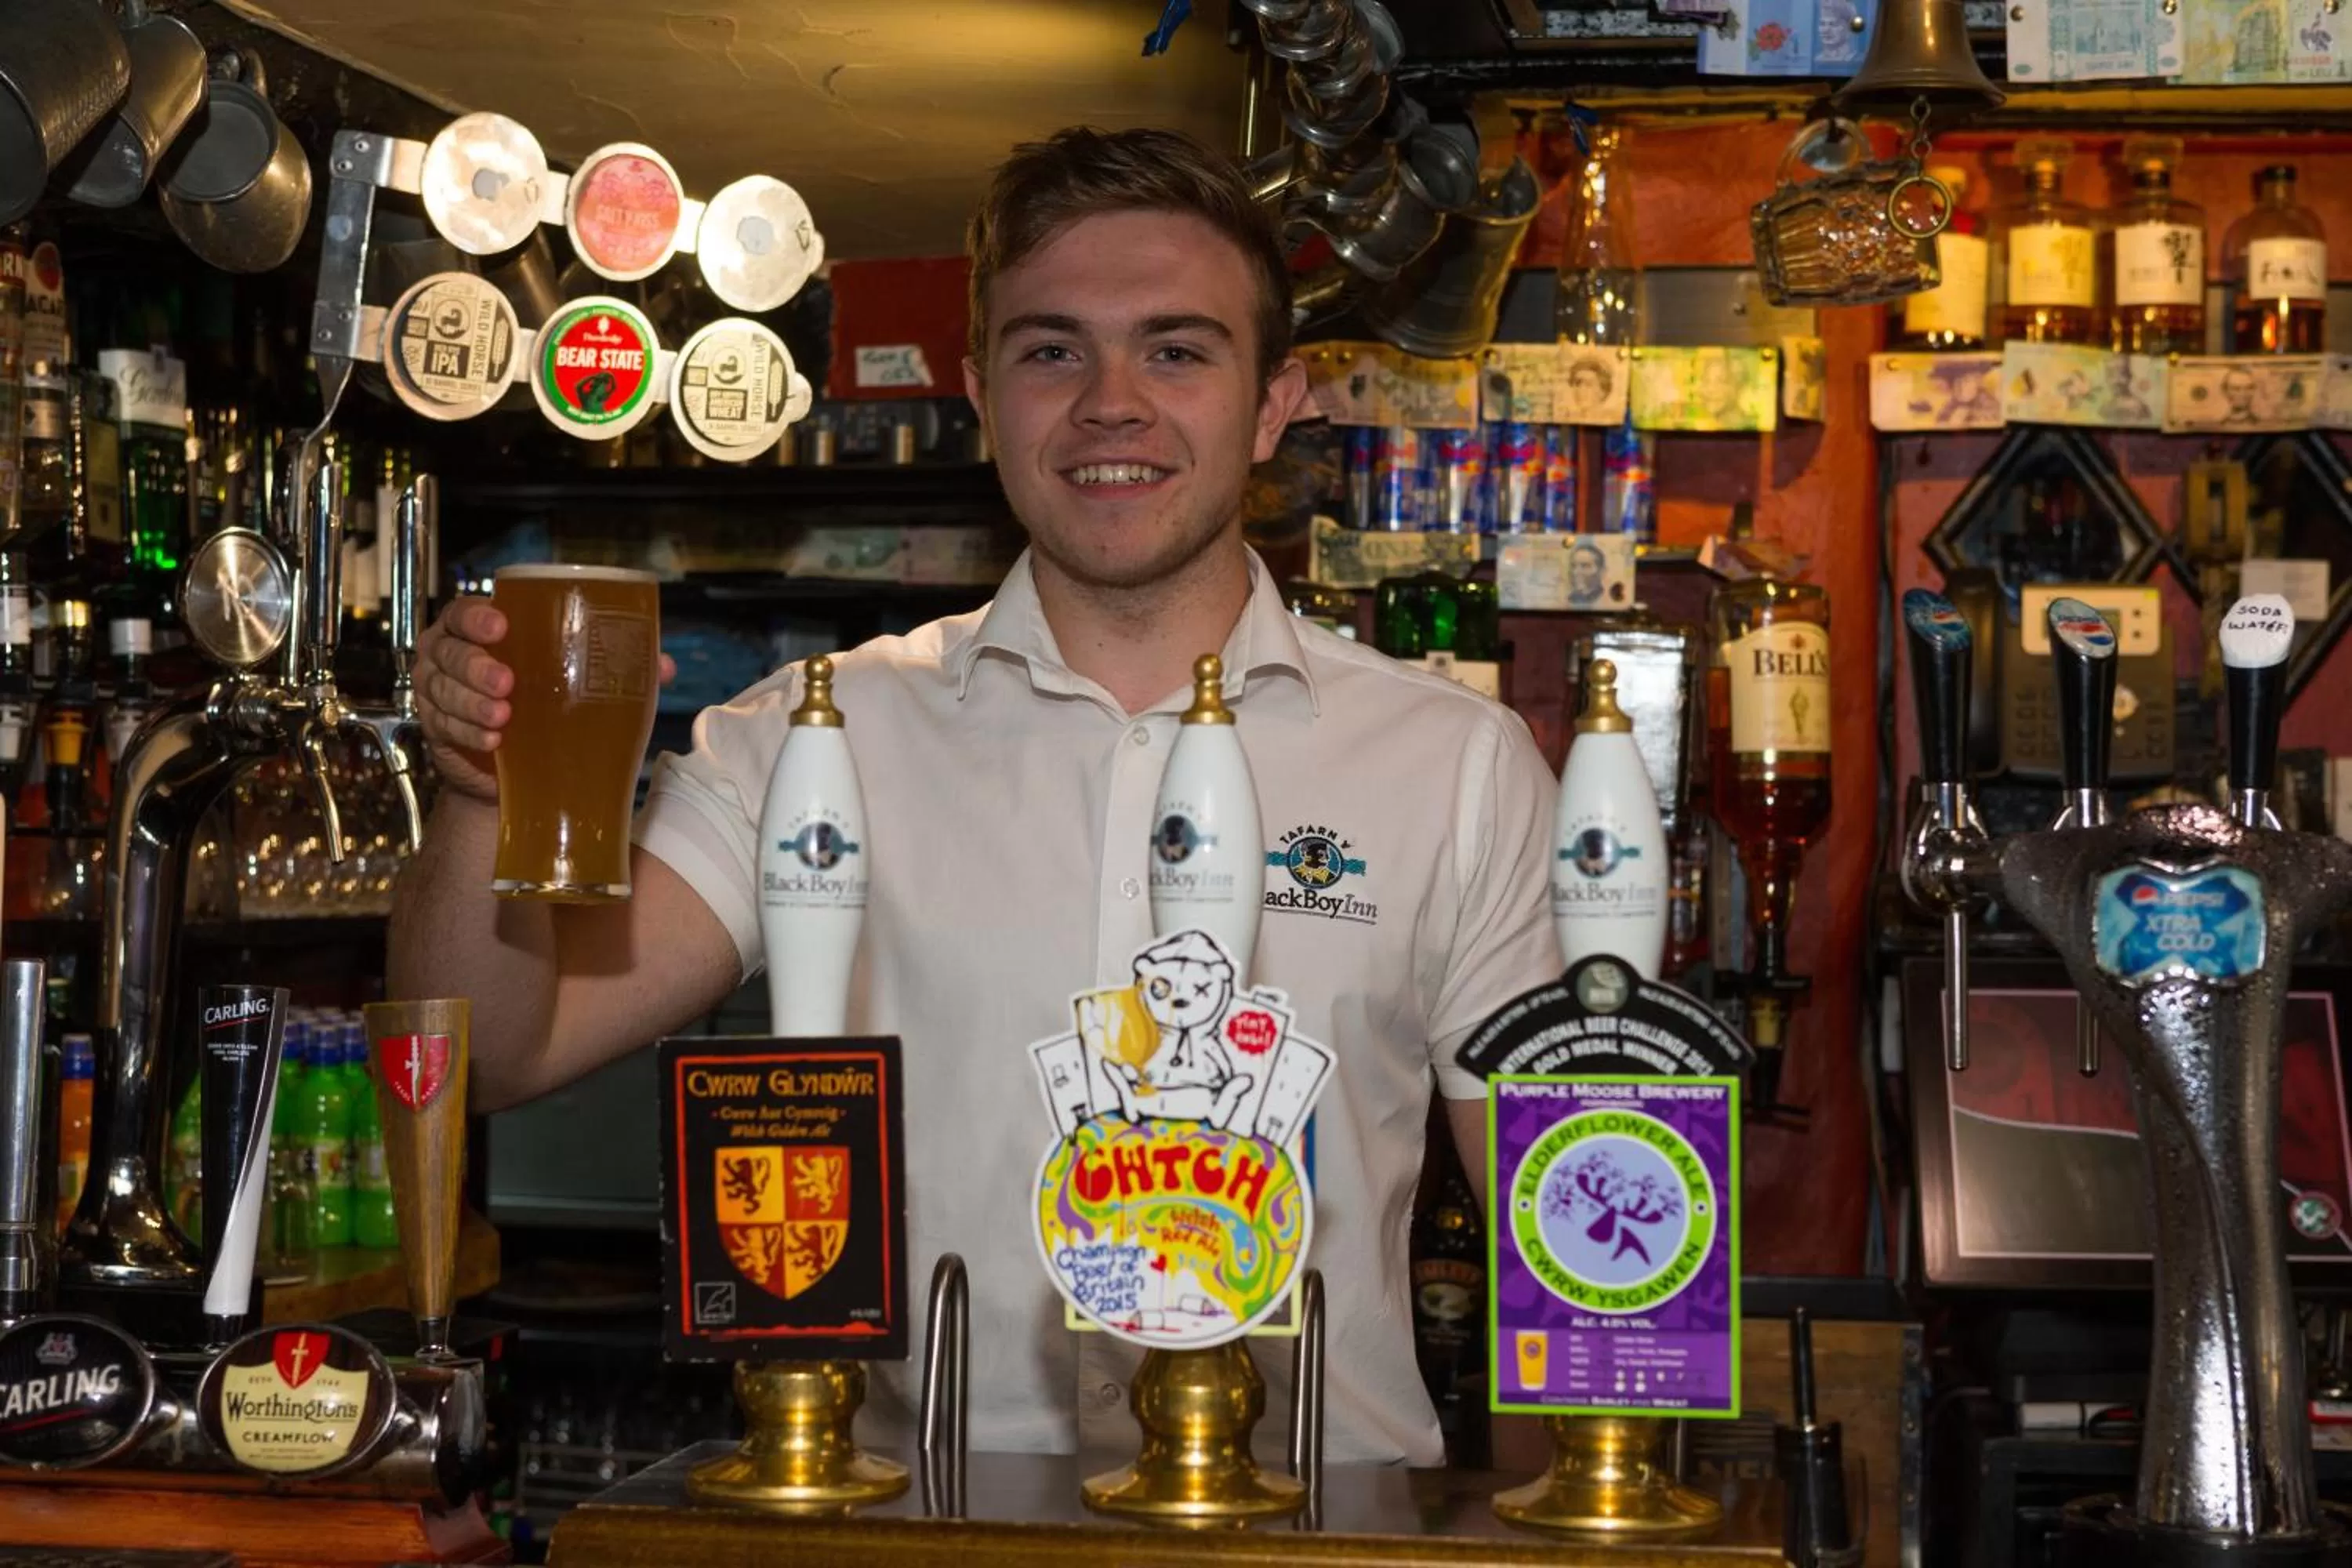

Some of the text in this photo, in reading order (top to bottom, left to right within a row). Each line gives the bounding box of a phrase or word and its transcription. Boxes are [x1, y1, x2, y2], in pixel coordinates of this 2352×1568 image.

[472, 298, 493, 378] WILD HORSE
[431, 350, 459, 376] IPA
[556, 345, 644, 372] BEAR STATE
[2236, 604, 2282, 617] SODA
[2227, 619, 2288, 634] WATER
[1279, 823, 1338, 844] TAFARN
[2163, 892, 2227, 907] PEPSI
[2146, 914, 2202, 932] XTRA
[2157, 932, 2216, 951] COLD
[204, 997, 268, 1025] CARLING
[1584, 1016, 1618, 1034] BEER
[1619, 1018, 1690, 1059] CHALLENGE
[1532, 1038, 1679, 1075] GOLD MEDAL WINNER
[687, 1069, 760, 1098] CWRW
[1499, 1083, 1726, 1100] PURPLE MOOSE BREWERY
[1519, 1114, 1709, 1197] ELDERFLOWER ALE
[1056, 1243, 1147, 1270] Champion
[1525, 1236, 1701, 1308] CWRW YSGAWEN
[1098, 1297, 1138, 1315] 2015
[225, 1390, 359, 1425] Worthington's
[241, 1430, 336, 1444] CREAMFLOW
